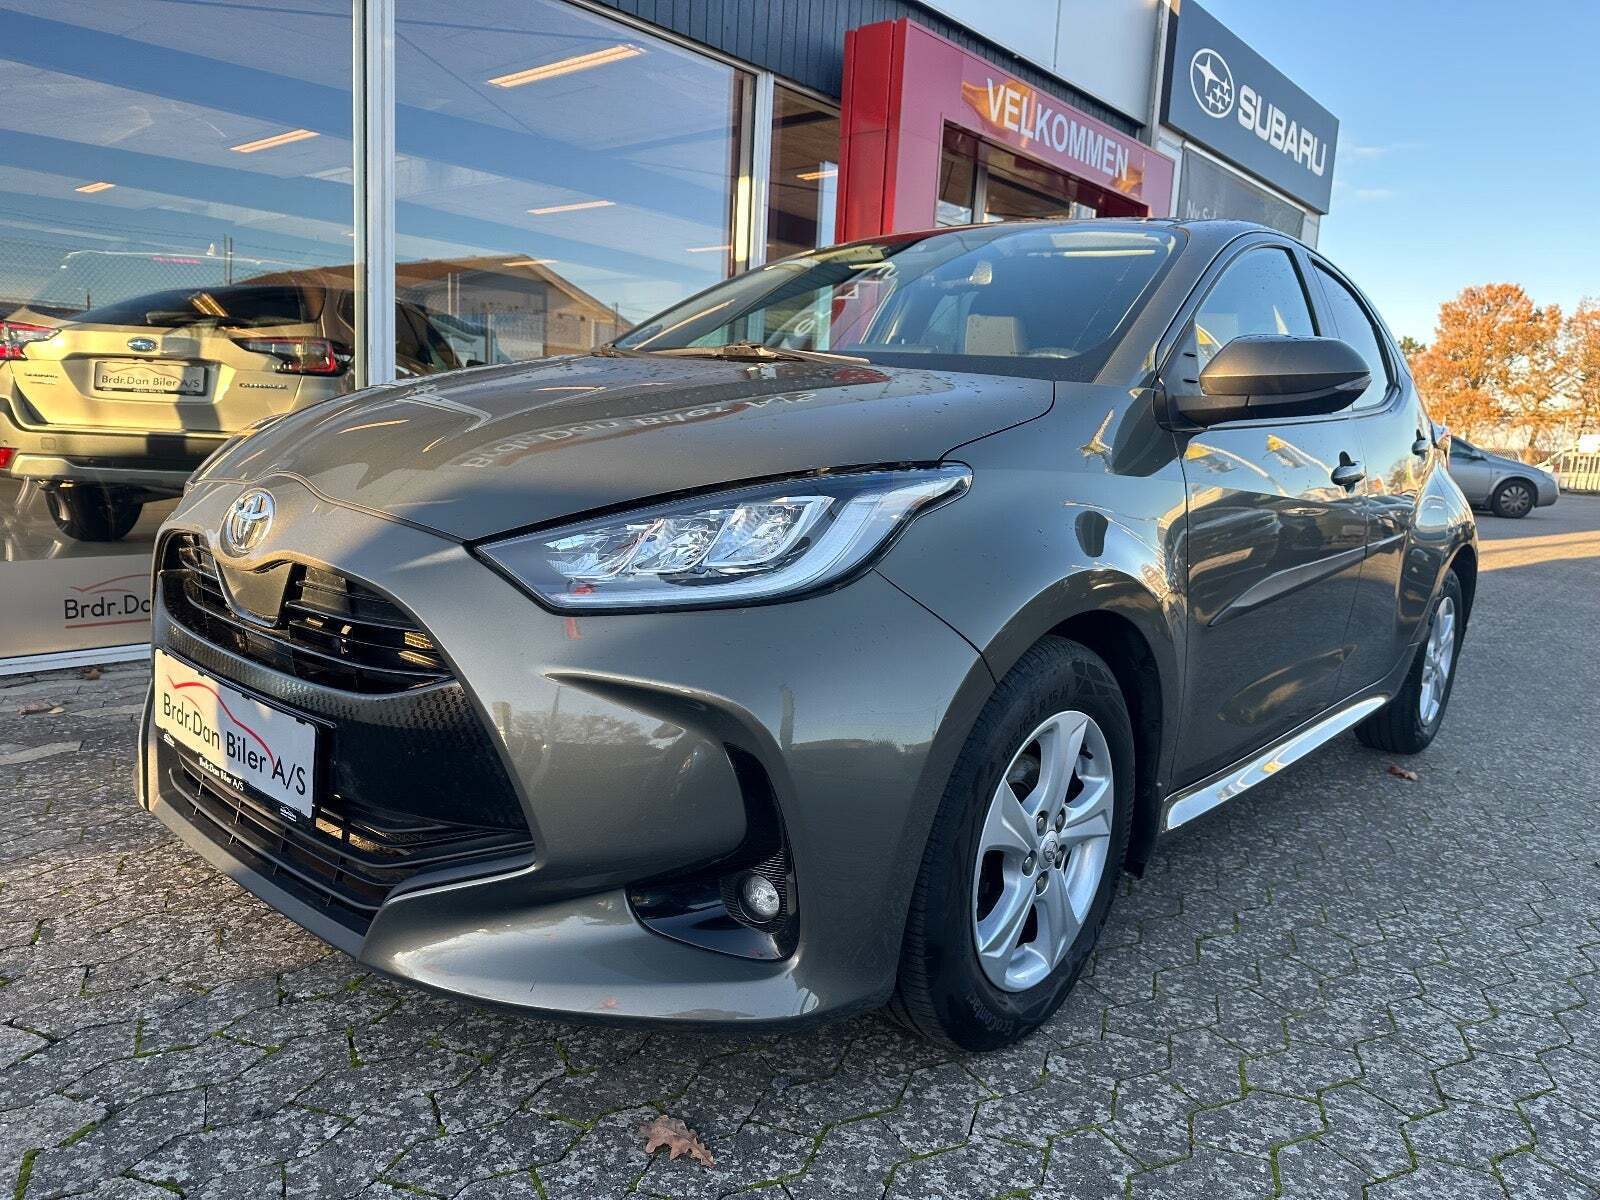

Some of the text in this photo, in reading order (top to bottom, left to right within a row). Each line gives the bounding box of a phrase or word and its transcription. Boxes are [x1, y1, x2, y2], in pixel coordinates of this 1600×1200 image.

[987, 78, 1129, 182] VELKOMMEN
[1237, 84, 1326, 177] SUBARU
[101, 375, 201, 389] Brdr.Dan Biler A/S
[64, 594, 151, 620] Brdr.Da
[162, 692, 307, 796] Brdr.Dan Biler A/S
